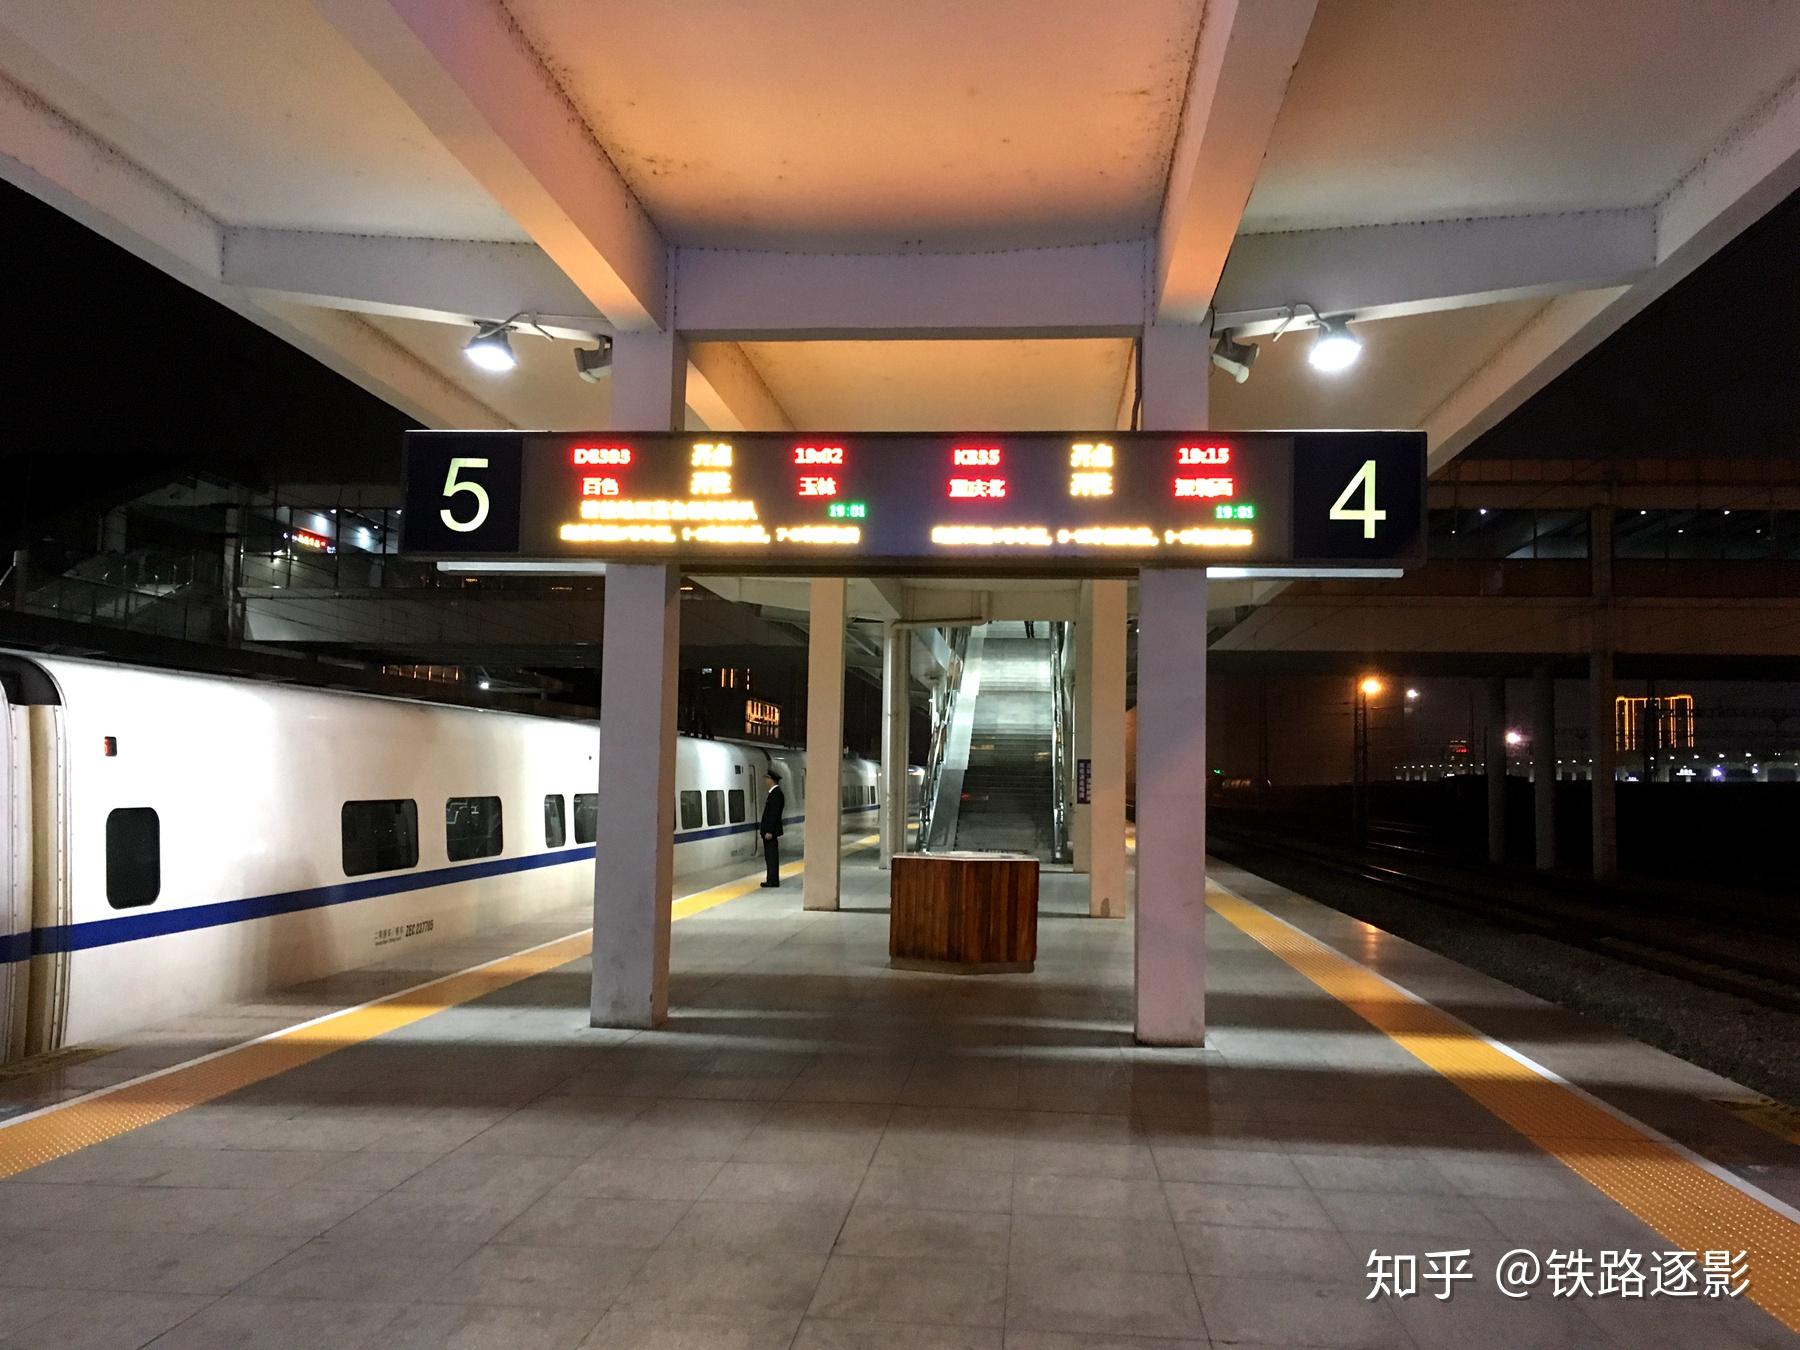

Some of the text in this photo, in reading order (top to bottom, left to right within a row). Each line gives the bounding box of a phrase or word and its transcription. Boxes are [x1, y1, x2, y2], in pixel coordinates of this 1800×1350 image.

[440, 457, 490, 532] 5
[582, 477, 620, 497] 百色
[798, 477, 838, 497] 玉林
[1329, 459, 1387, 539] 4
